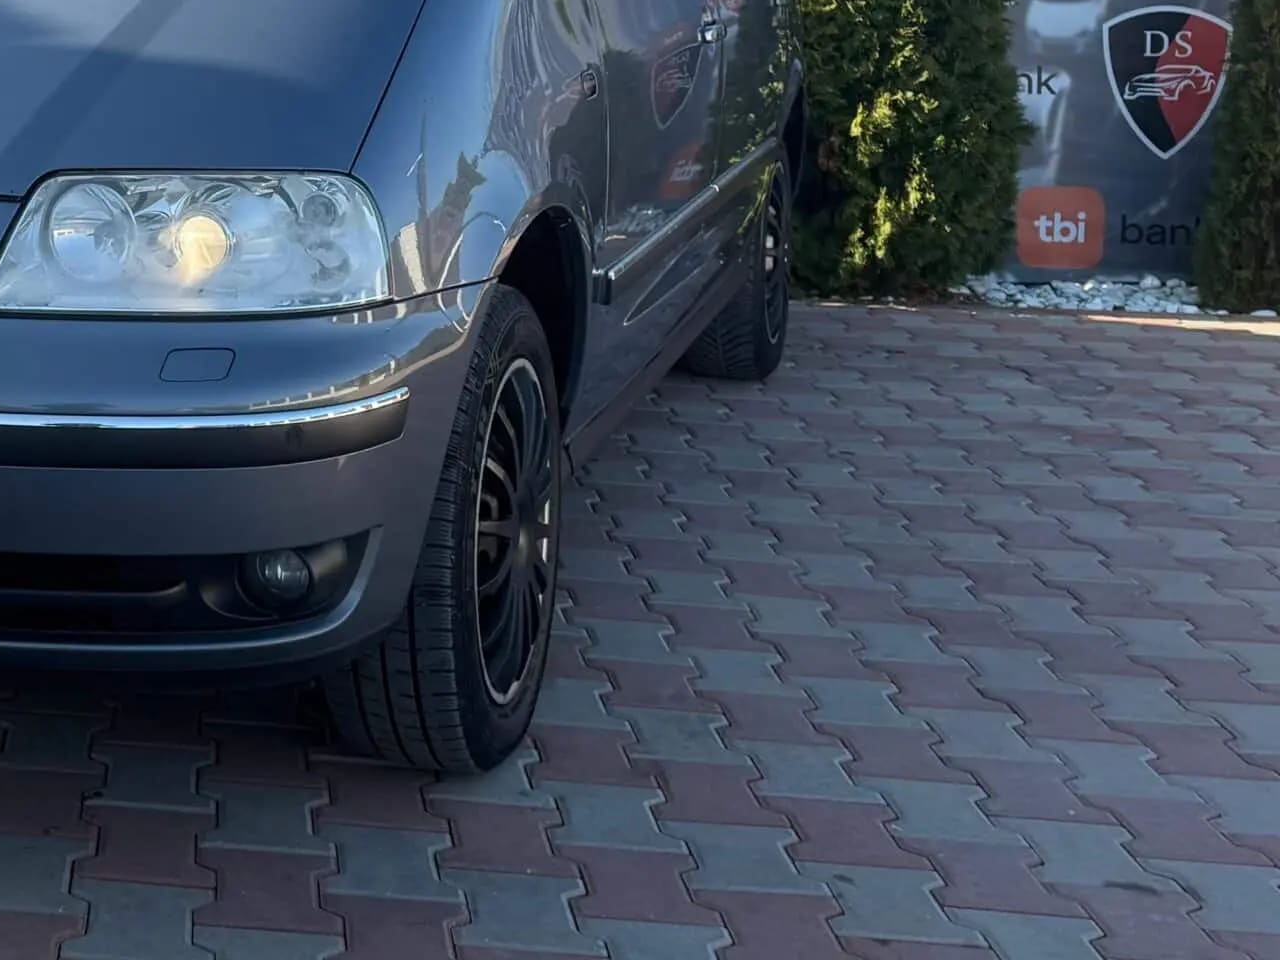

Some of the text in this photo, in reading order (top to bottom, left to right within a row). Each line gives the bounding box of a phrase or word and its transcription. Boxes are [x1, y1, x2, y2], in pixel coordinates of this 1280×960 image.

[1143, 29, 1193, 58] DS
[1033, 211, 1201, 246] tbi ban
